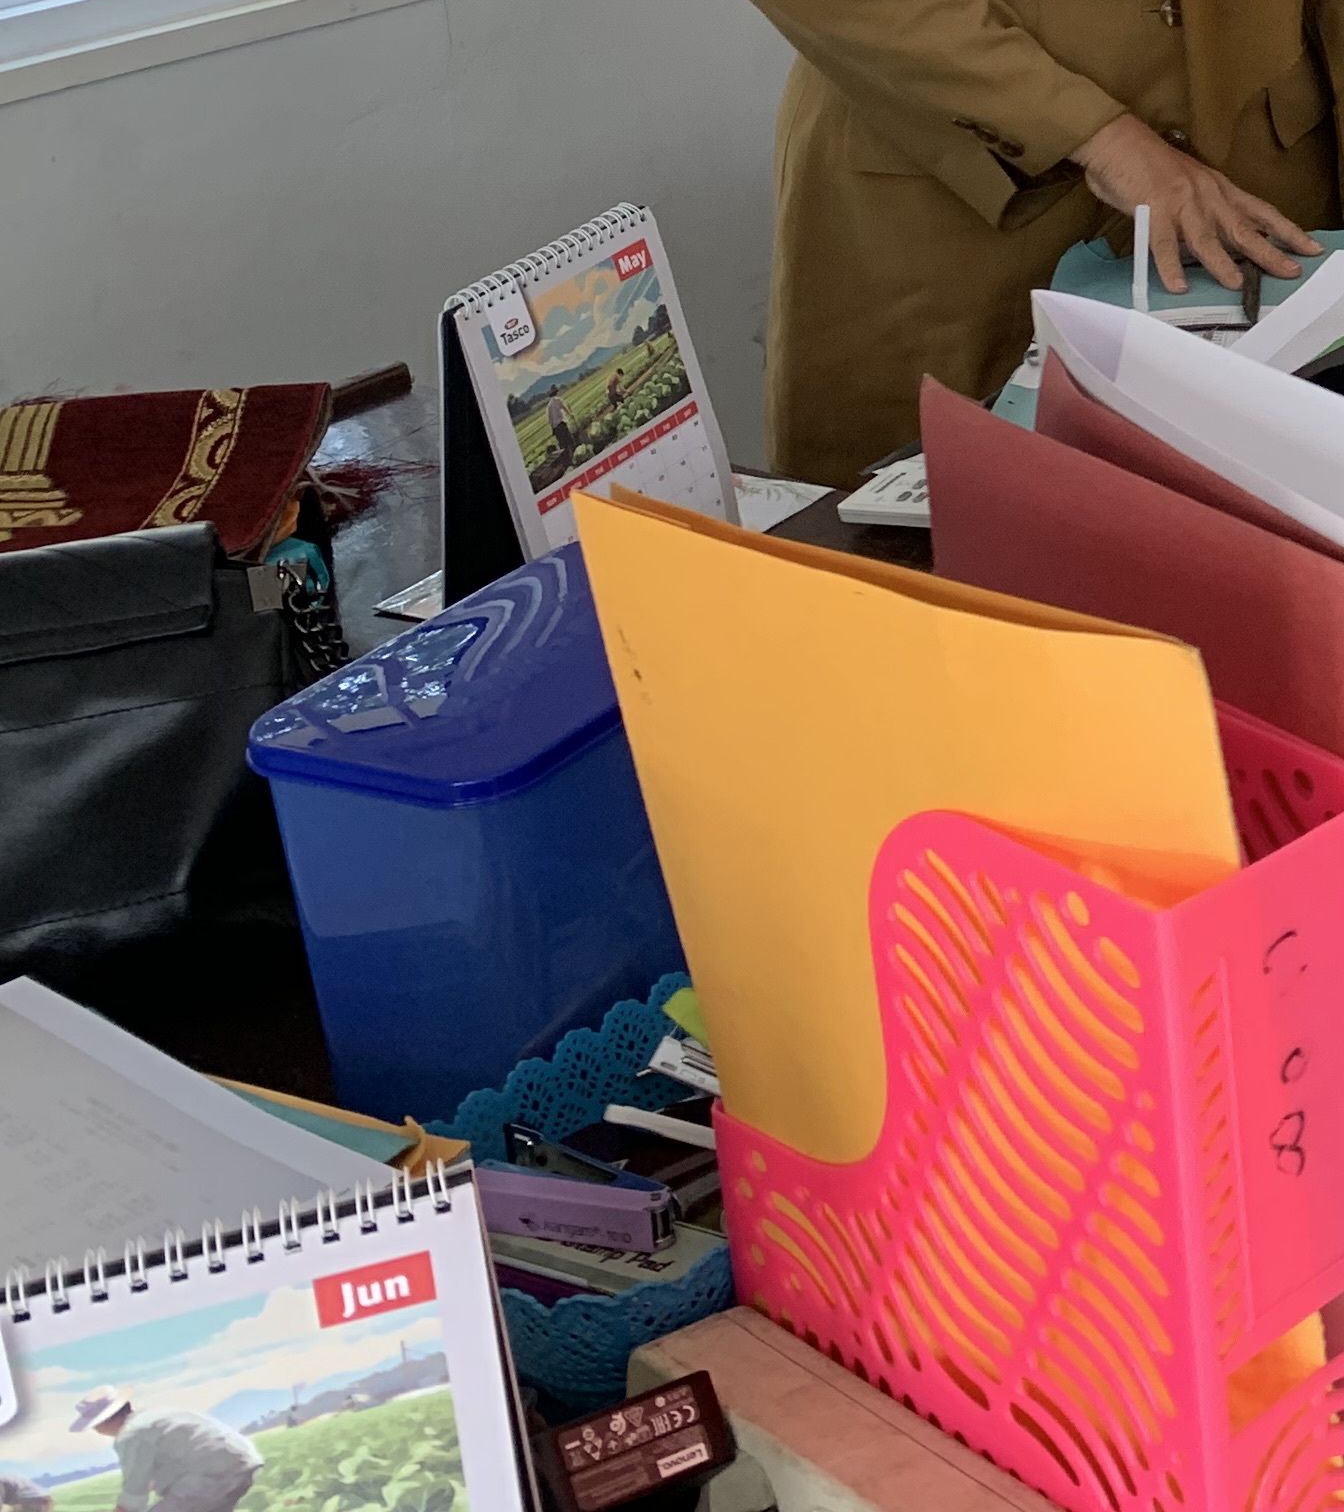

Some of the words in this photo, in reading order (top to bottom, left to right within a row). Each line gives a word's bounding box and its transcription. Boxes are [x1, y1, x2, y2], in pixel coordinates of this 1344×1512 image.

[618, 249, 646, 275] May
[500, 325, 529, 346] Tasco
[626, 1251, 674, 1273] Pad
[341, 1275, 410, 1319] Jun
[663, 1449, 703, 1470] Lenovo
